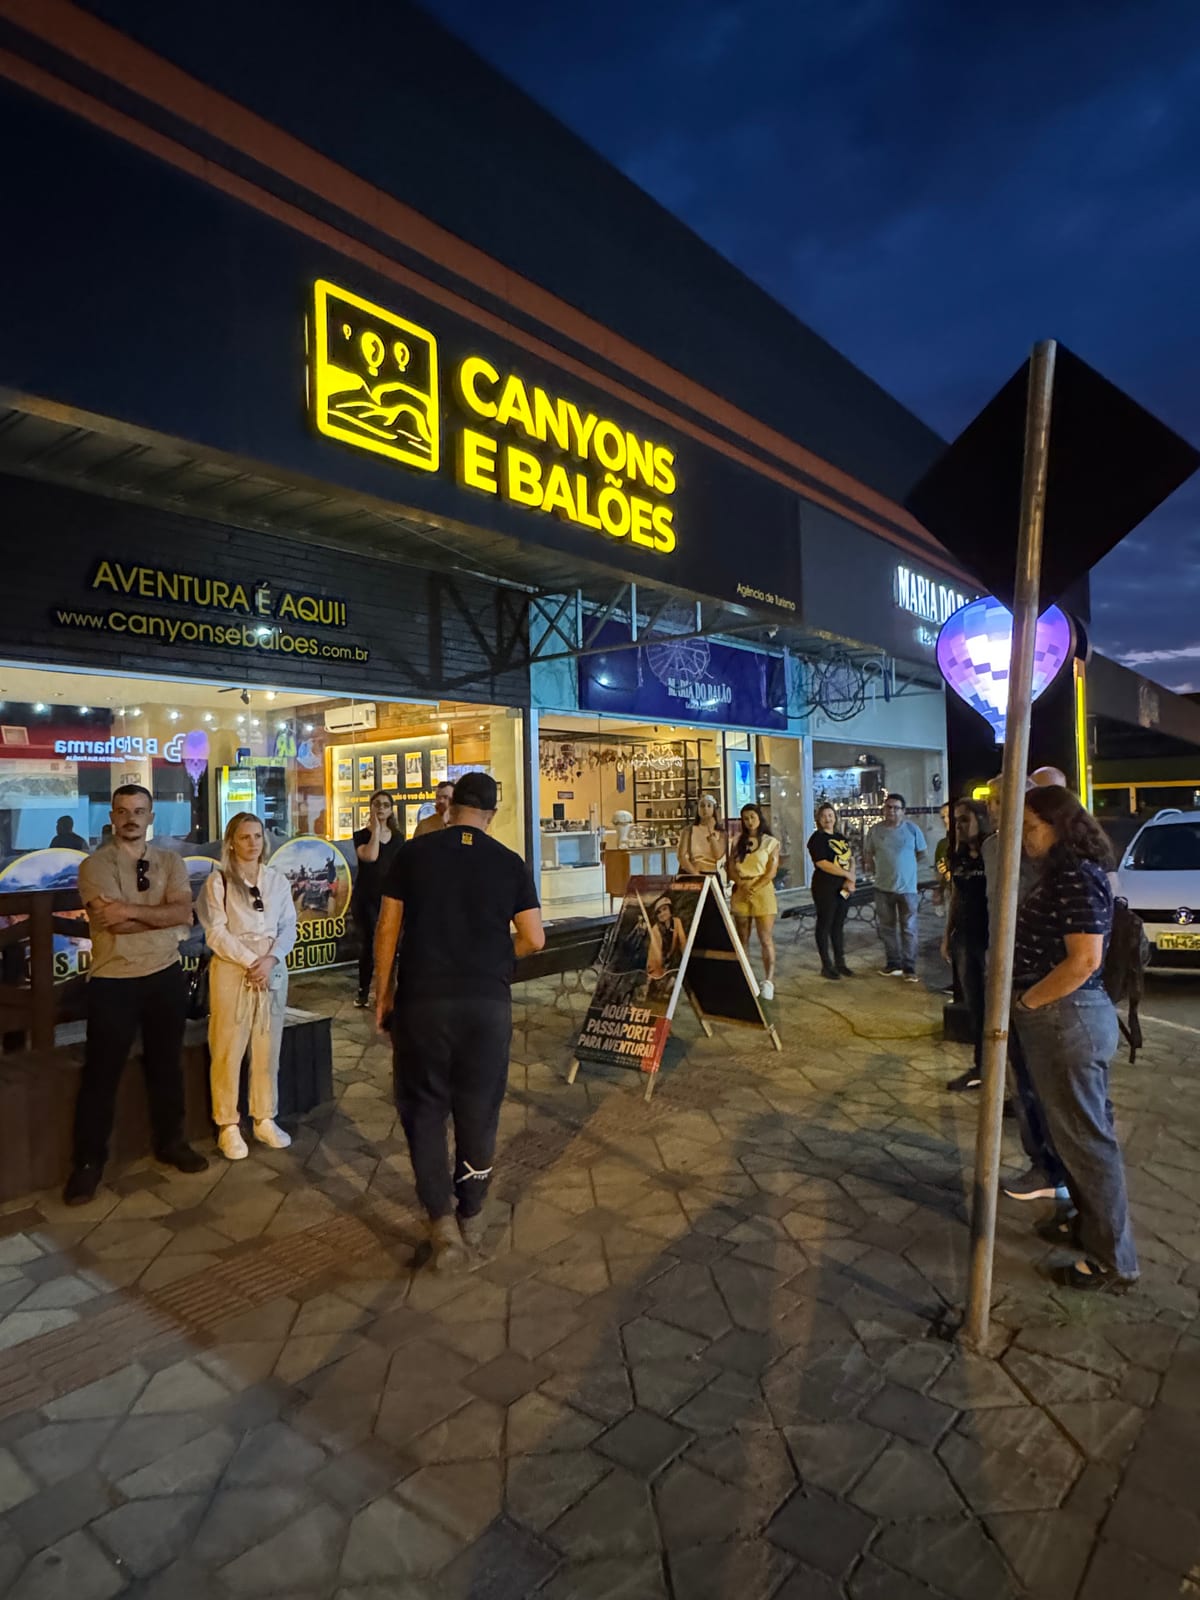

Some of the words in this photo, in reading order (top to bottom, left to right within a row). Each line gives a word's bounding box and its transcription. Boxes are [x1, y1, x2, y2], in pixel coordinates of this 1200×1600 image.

[459, 356, 676, 495] CANYONS
[463, 428, 498, 493] E
[507, 446, 676, 554] BALÕES
[92, 561, 250, 612] AVENTURA
[255, 581, 271, 615] É
[279, 593, 347, 626] AQUI!
[736, 582, 764, 601] Agência
[765, 592, 774, 604] de
[897, 565, 938, 621] MARIA
[938, 585, 956, 623] DO
[668, 677, 694, 698] MARIA
[695, 682, 706, 700] DO
[707, 683, 732, 703] BALÃO
[306, 942, 336, 966] UTV
[601, 1004, 629, 1019] AQUI
[629, 1006, 652, 1024] TEM
[577, 1033, 602, 1051] PARA
[586, 1018, 657, 1041] PASSAPORTE
